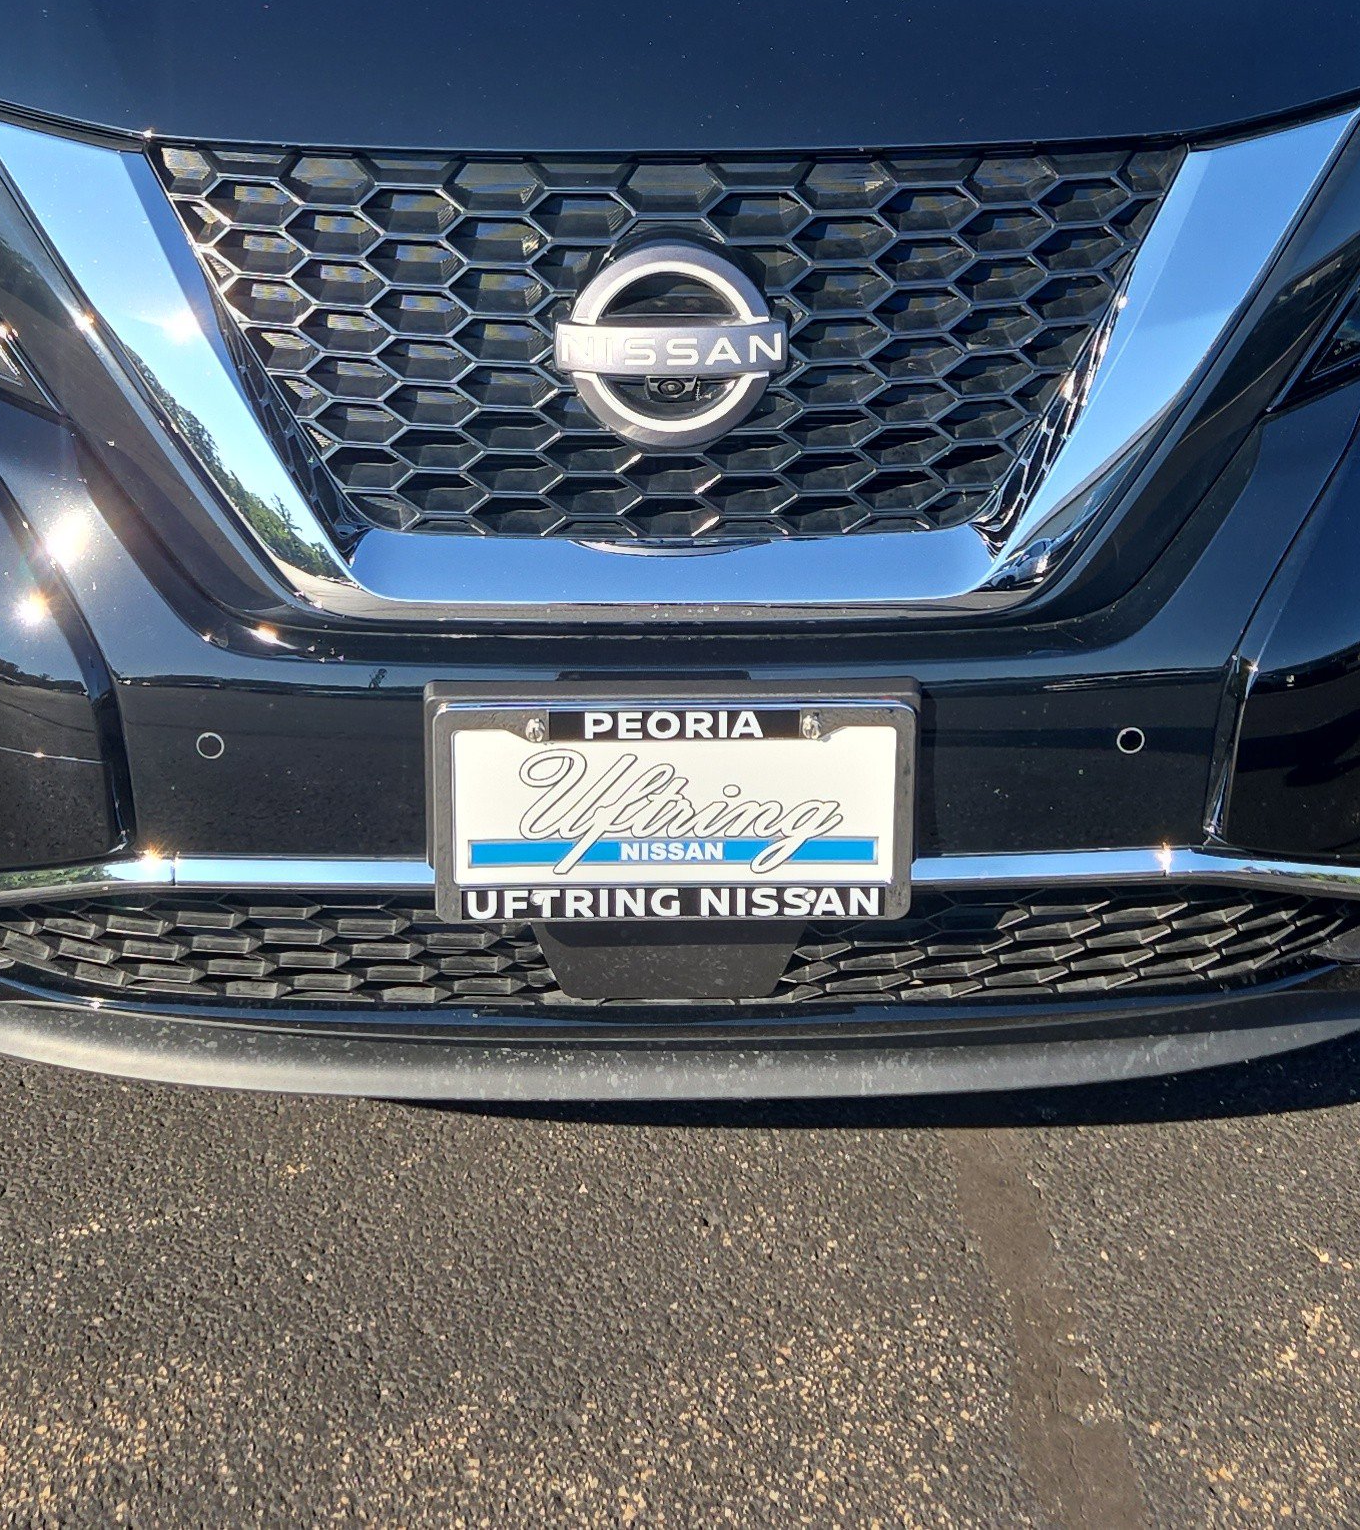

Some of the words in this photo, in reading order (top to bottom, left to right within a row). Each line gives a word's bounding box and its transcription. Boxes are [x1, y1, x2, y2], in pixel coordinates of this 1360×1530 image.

[560, 332, 782, 366] NISSAN
[583, 710, 764, 739] PEORIA
[519, 748, 844, 875] Uftring
[620, 842, 724, 861] NISSAN
[467, 888, 681, 920] UFTRING
[700, 888, 880, 918] NISSAN
